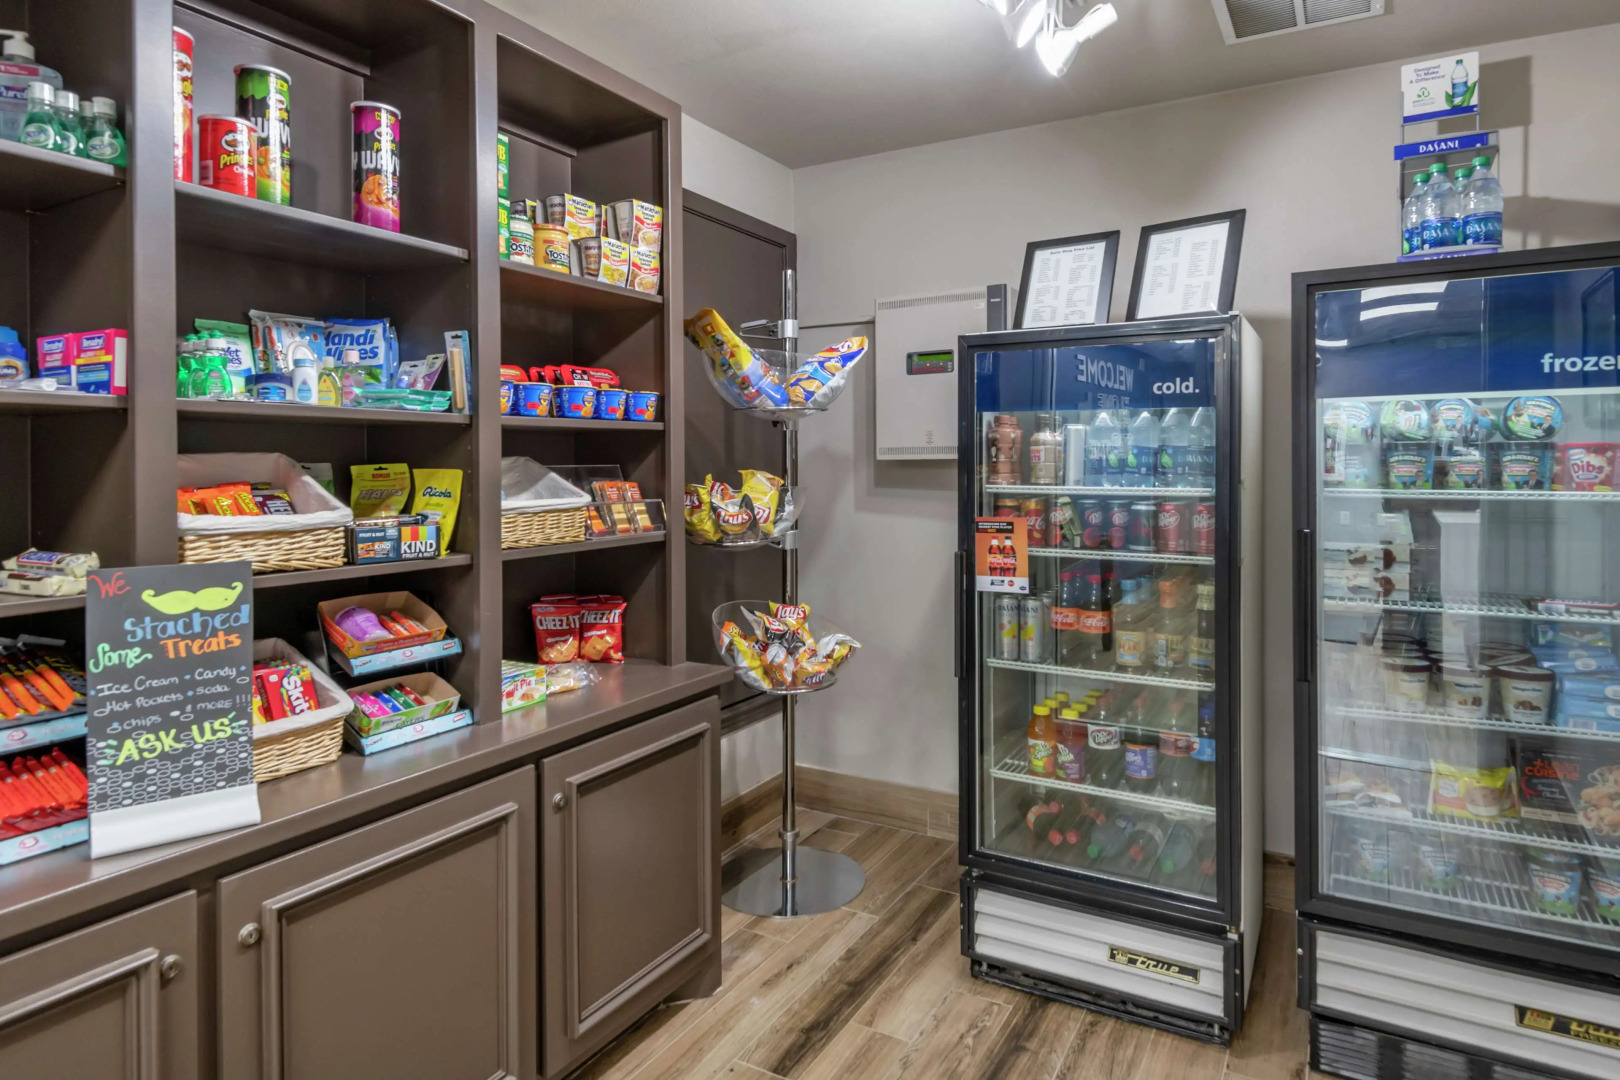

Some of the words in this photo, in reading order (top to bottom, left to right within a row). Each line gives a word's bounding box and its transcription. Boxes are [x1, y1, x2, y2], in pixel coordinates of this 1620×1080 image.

[1419, 140, 1459, 153] DASANI
[326, 346, 380, 360] Wies
[1152, 376, 1200, 395] cold.
[1570, 460, 1604, 475] Dibs
[422, 486, 452, 498] Ricola
[401, 541, 436, 554] KIND
[88, 571, 132, 599] We
[124, 604, 250, 642] Stached
[160, 631, 242, 659] Treats
[97, 682, 132, 696] Ice
[134, 676, 180, 692] Cream
[194, 666, 237, 680] Candy
[136, 693, 184, 708] Pockets
[116, 728, 186, 766] ASK
